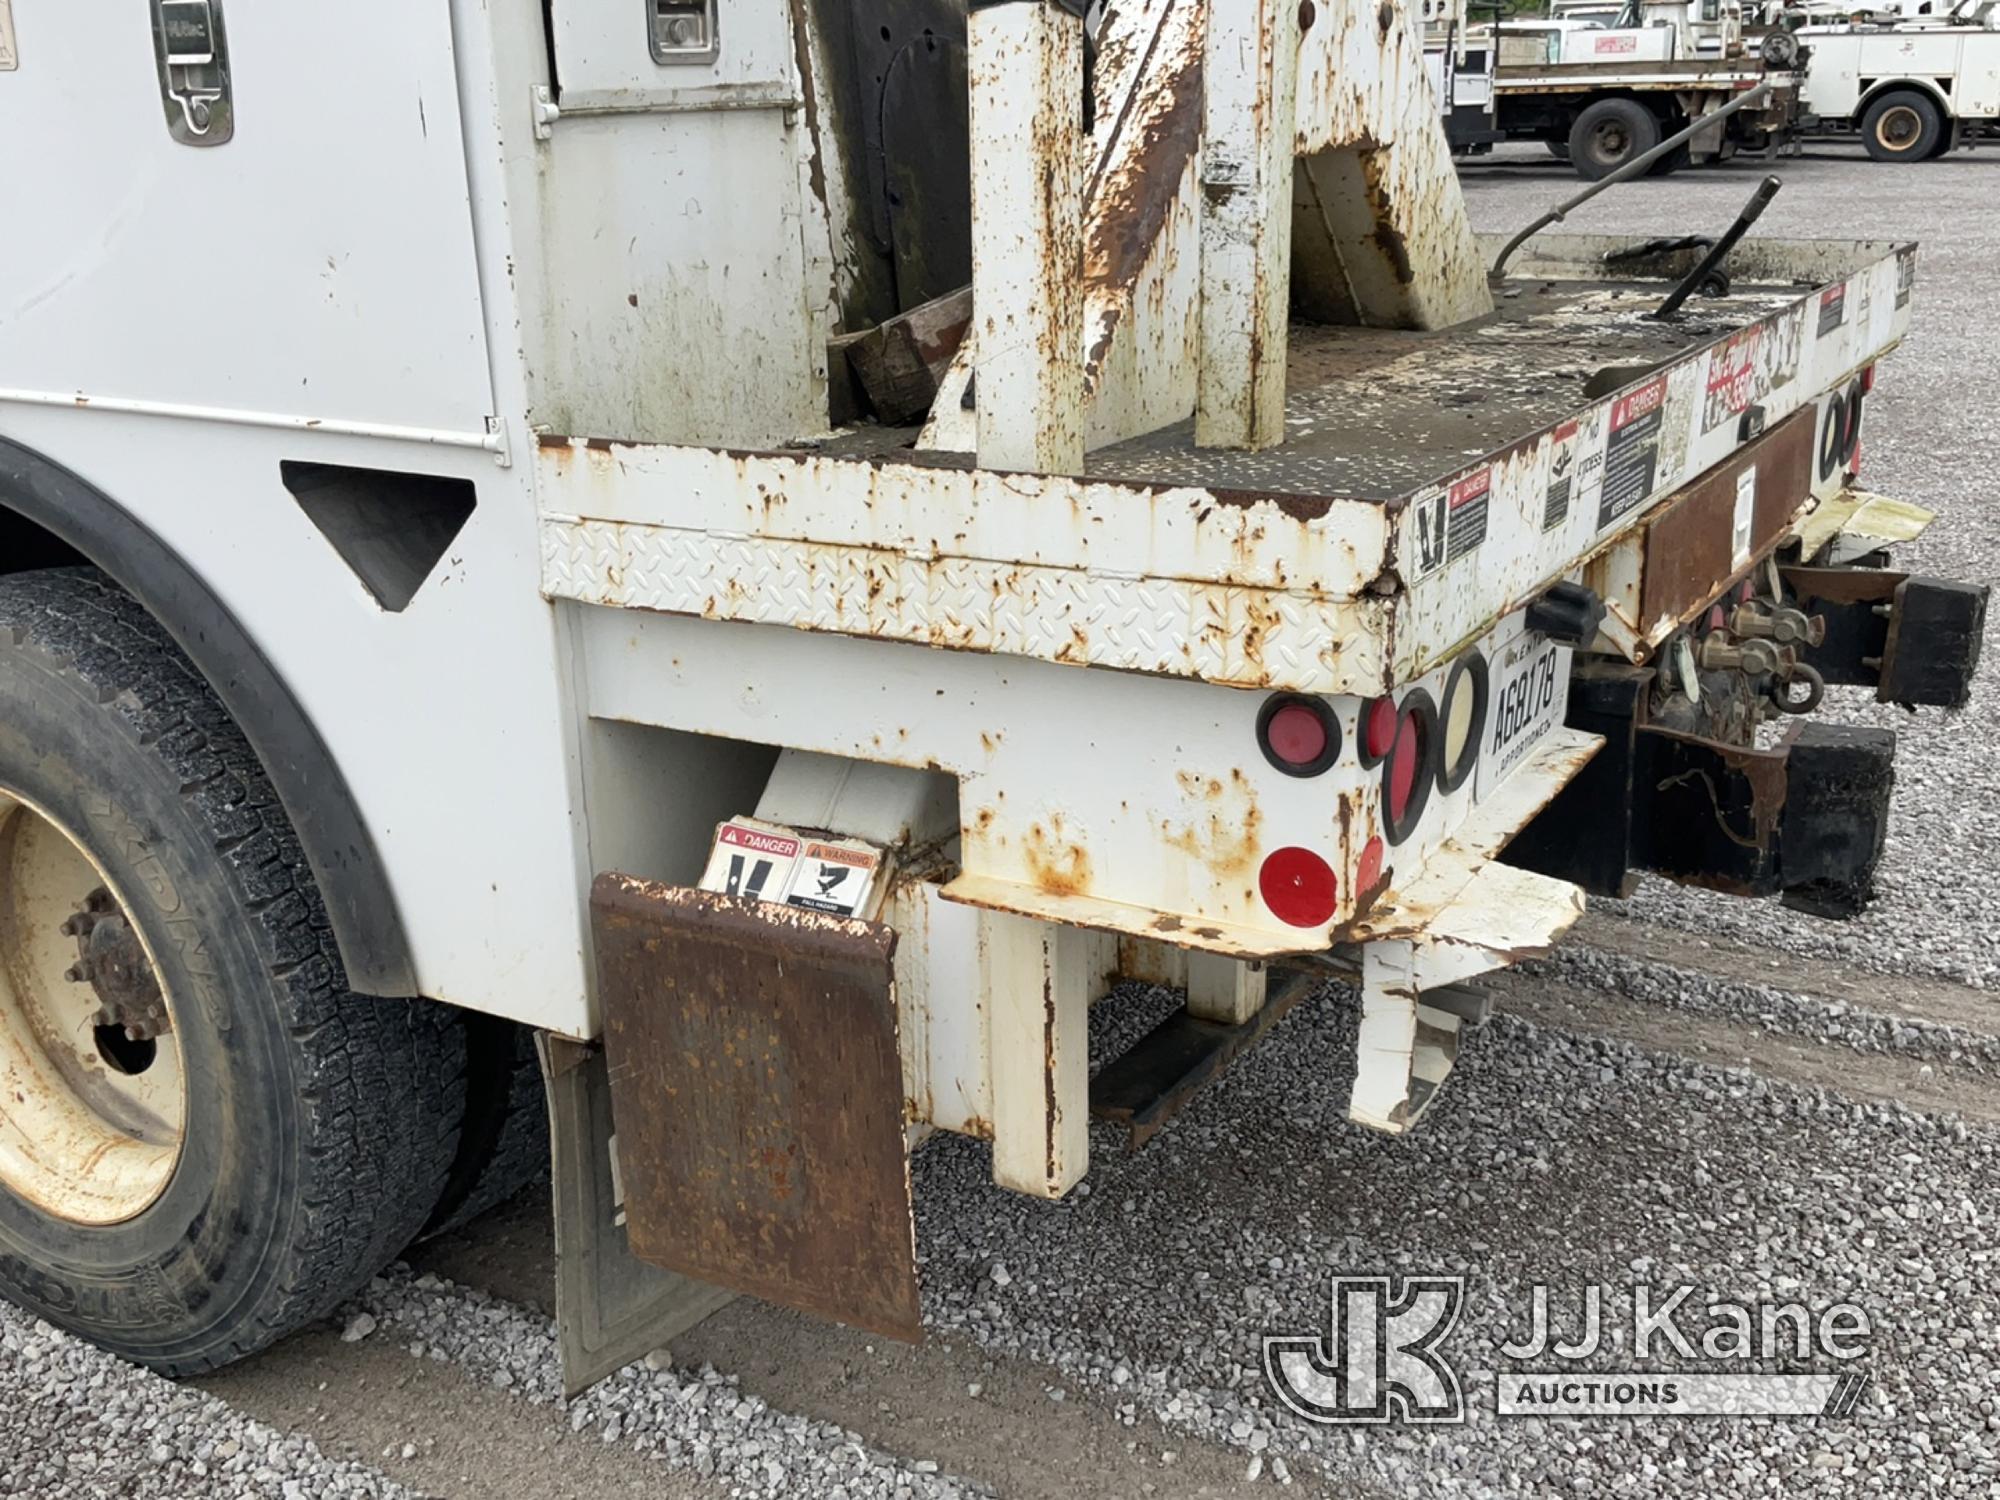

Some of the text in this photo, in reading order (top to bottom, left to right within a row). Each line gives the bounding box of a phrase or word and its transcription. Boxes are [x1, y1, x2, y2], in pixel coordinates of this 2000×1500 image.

[1628, 384, 1661, 418] DANGER
[1463, 471, 1489, 498] DANGER
[1492, 646, 1556, 756] A68178
[1500, 718, 1551, 772] APPORTIONED
[743, 834, 795, 855] DANGER
[823, 848, 870, 867] WARNING
[801, 898, 816, 907] FALL
[815, 900, 839, 912] HAZARD
